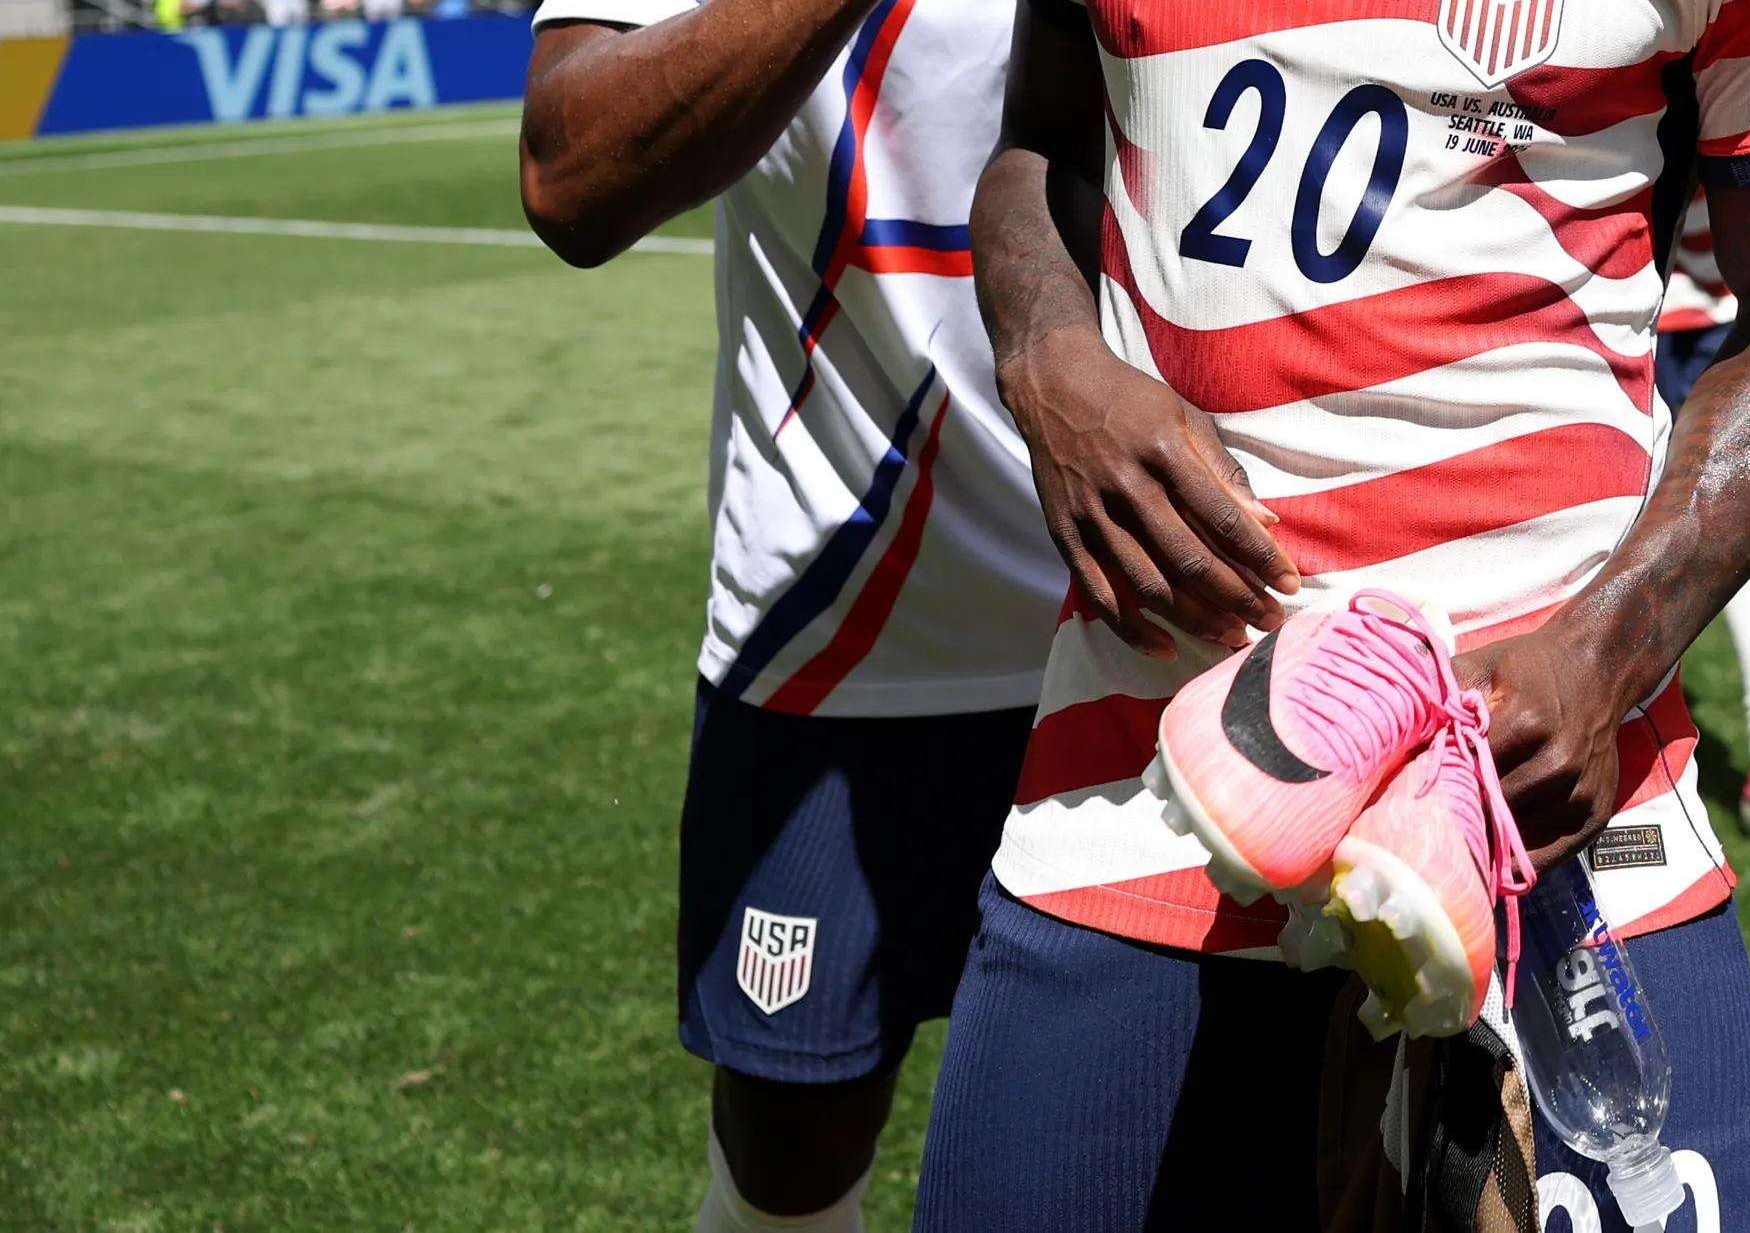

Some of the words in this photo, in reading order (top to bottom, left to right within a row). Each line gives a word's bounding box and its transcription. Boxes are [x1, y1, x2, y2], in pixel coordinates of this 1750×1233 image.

[174, 18, 438, 120] VISA
[1430, 92, 1458, 108] USA
[1462, 97, 1482, 113] VS.
[1448, 114, 1508, 141] SEATTLE,
[1513, 124, 1535, 141] WA
[1445, 134, 1460, 150] 19
[1462, 137, 1499, 157] JUNE
[1179, 58, 1408, 283] 20
[747, 916, 810, 957] USA
